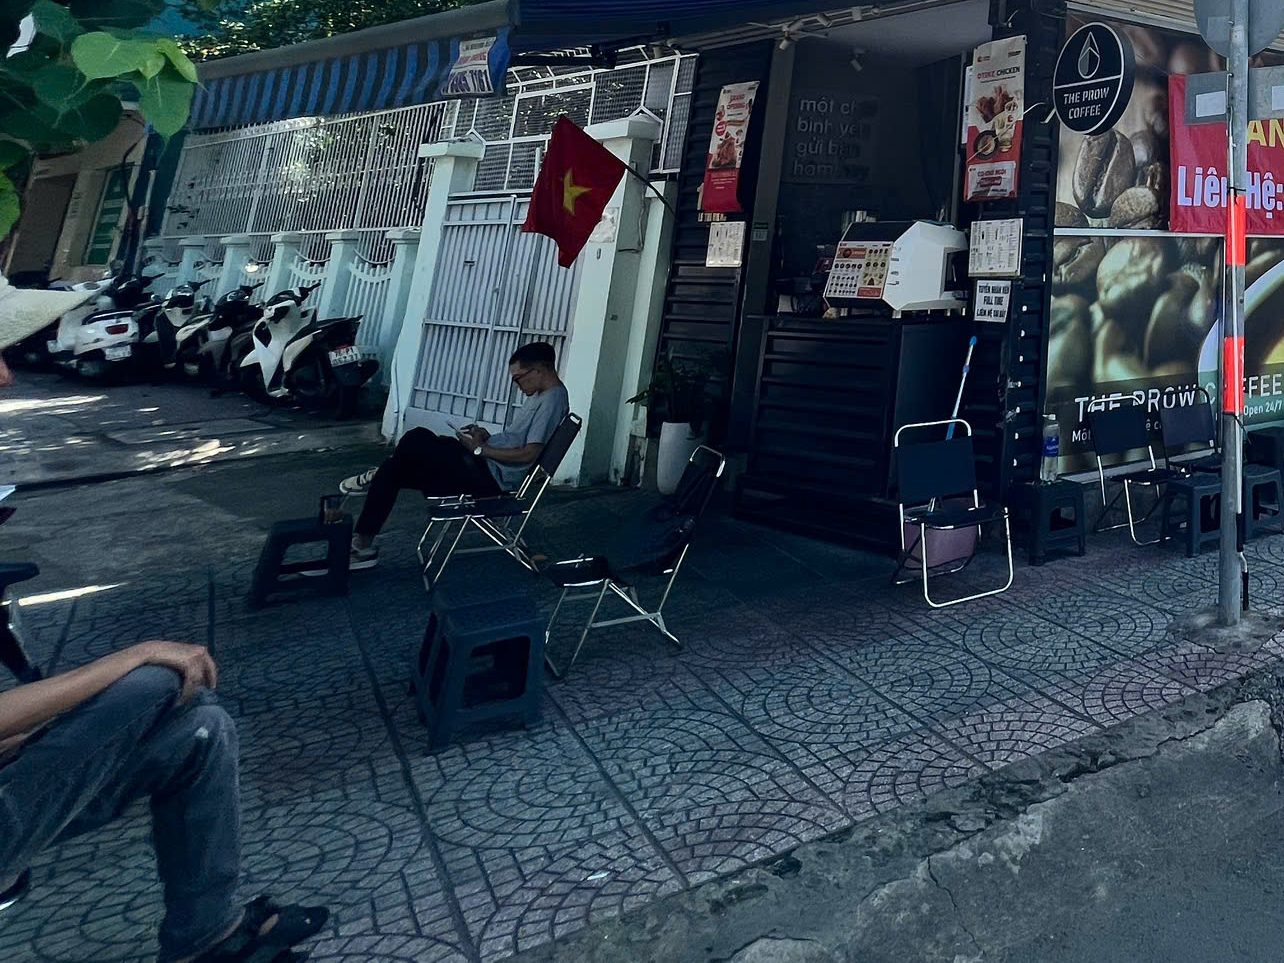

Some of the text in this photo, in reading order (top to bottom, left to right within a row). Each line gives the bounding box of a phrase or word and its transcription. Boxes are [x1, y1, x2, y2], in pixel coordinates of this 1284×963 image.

[996, 66, 1021, 77] CHICKEN
[1063, 86, 1110, 105] THE PROW
[1068, 103, 1102, 120] COFFEE
[1246, 170, 1284, 220] Hệ:
[1243, 399, 1283, 417] Open 24/7
